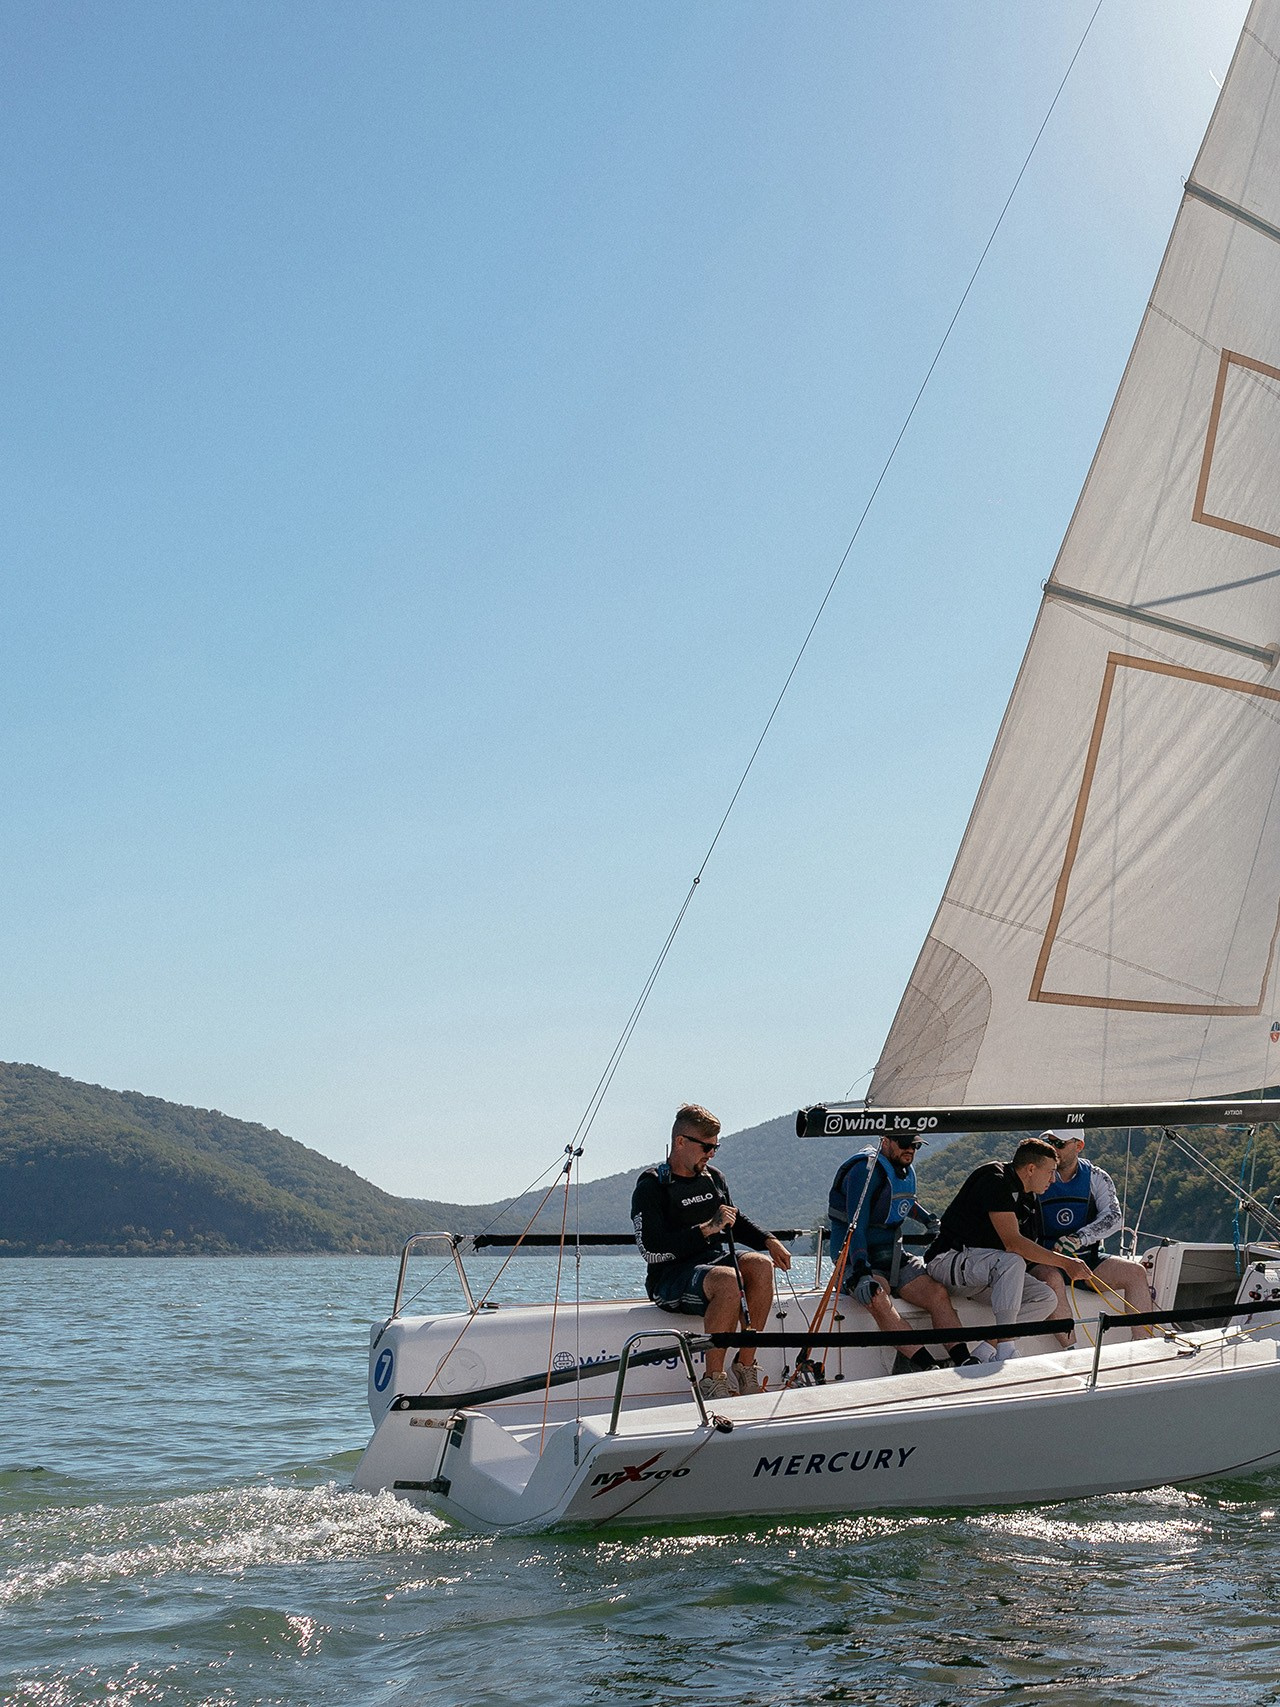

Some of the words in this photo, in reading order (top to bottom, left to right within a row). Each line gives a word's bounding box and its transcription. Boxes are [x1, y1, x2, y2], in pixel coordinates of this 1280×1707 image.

[845, 1114, 938, 1131] wind_to_go
[1066, 1113, 1085, 1123] ГИК
[681, 1192, 713, 1206] SMELO
[377, 1354, 391, 1386] 7
[752, 1446, 917, 1478] MERCURY
[591, 1450, 691, 1499] MX700
